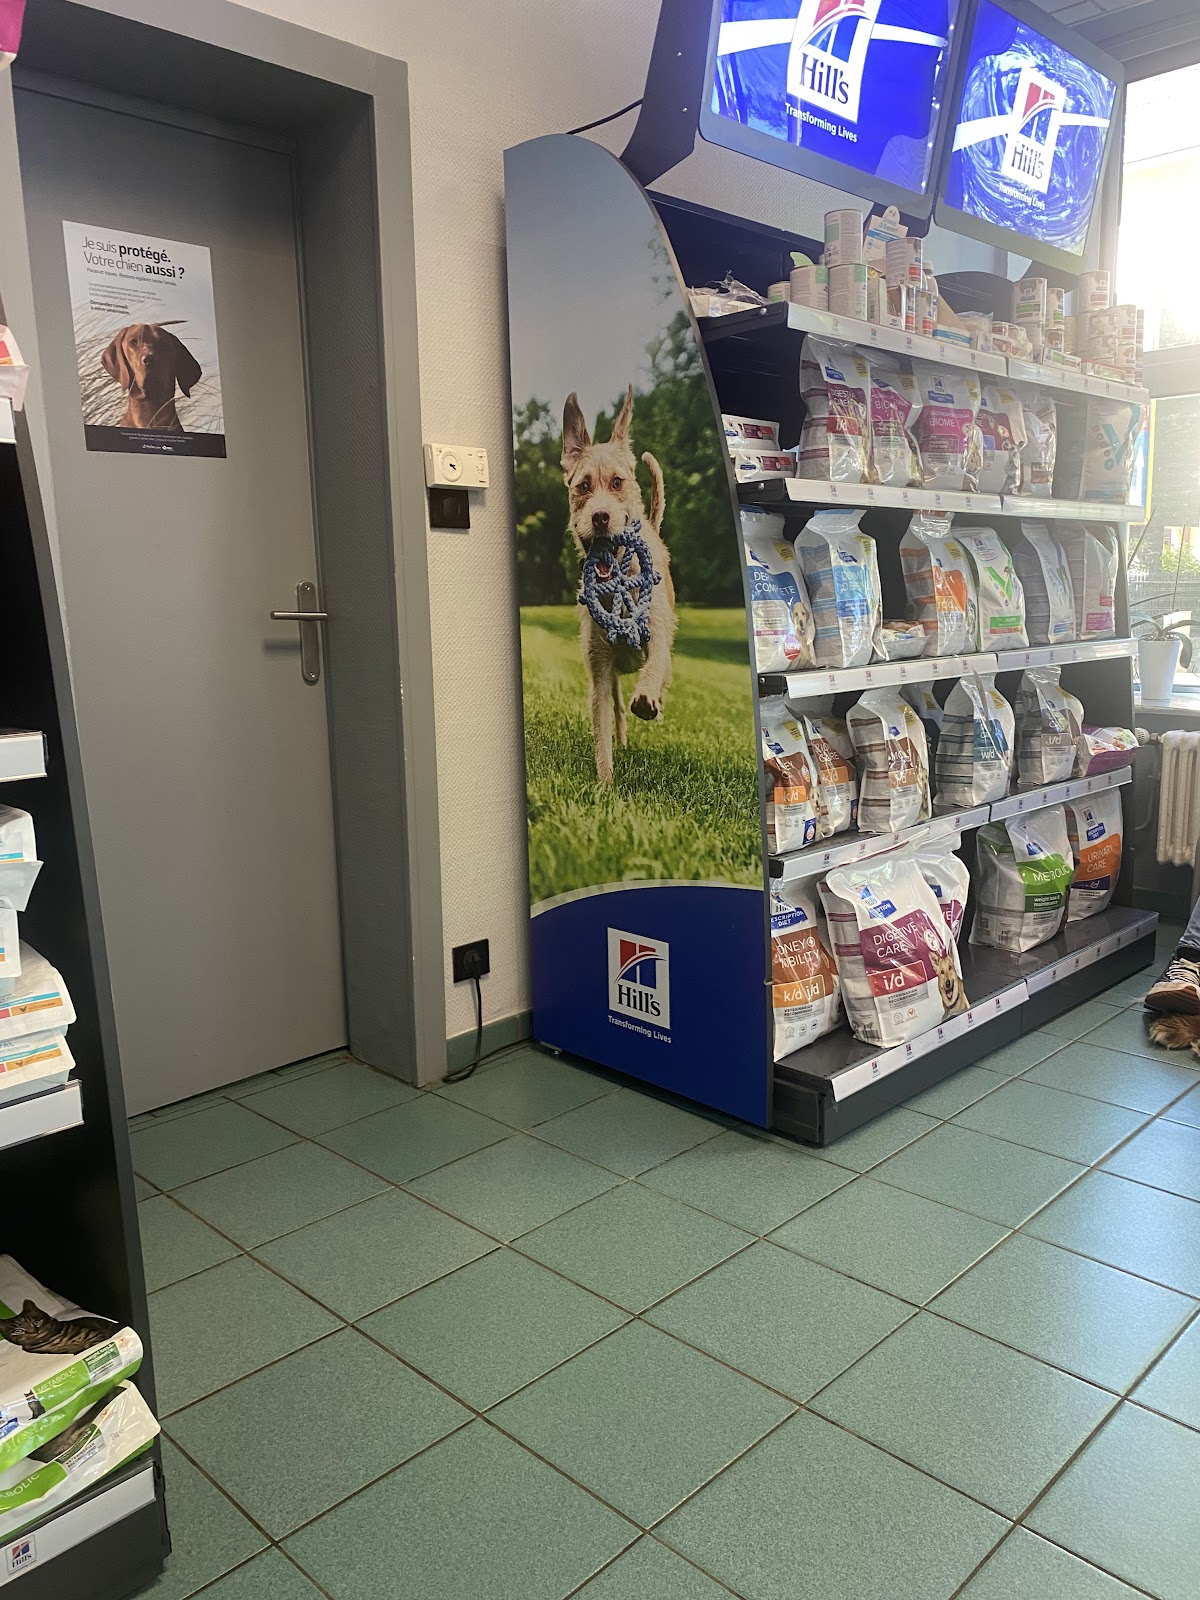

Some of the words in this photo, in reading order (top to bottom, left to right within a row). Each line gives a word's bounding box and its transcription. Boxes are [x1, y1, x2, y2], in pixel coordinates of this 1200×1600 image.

[799, 52, 849, 105] Hill's
[785, 102, 837, 136] Transforming
[837, 125, 858, 143] Lives
[1011, 140, 1045, 182] Hill's
[998, 182, 1032, 208] Transforming
[82, 236, 95, 250] Je
[96, 241, 117, 254] suis
[119, 244, 171, 264] protégé.
[83, 251, 115, 268] Votre
[116, 258, 144, 273] chien
[145, 264, 176, 278] aussi
[178, 267, 185, 279] ?
[929, 417, 956, 427] BIOME
[785, 642, 801, 650] NEW
[981, 749, 995, 759] w/d
[784, 790, 799, 802] k/d
[1087, 844, 1113, 863] URINARY
[1086, 858, 1107, 873] CARE
[770, 911, 804, 923] ESCRIPTION
[778, 919, 792, 927] DIET
[876, 940, 907, 958] CARE
[883, 971, 905, 990] i/d
[617, 983, 661, 1017] Hill's
[784, 988, 803, 1002] k/d
[805, 983, 820, 1001] j/d
[608, 1015, 652, 1038] Transforming
[653, 1031, 672, 1044] Lives
[38, 1367, 77, 1393] METABOLIC
[12, 1553, 32, 1568] Hill's
